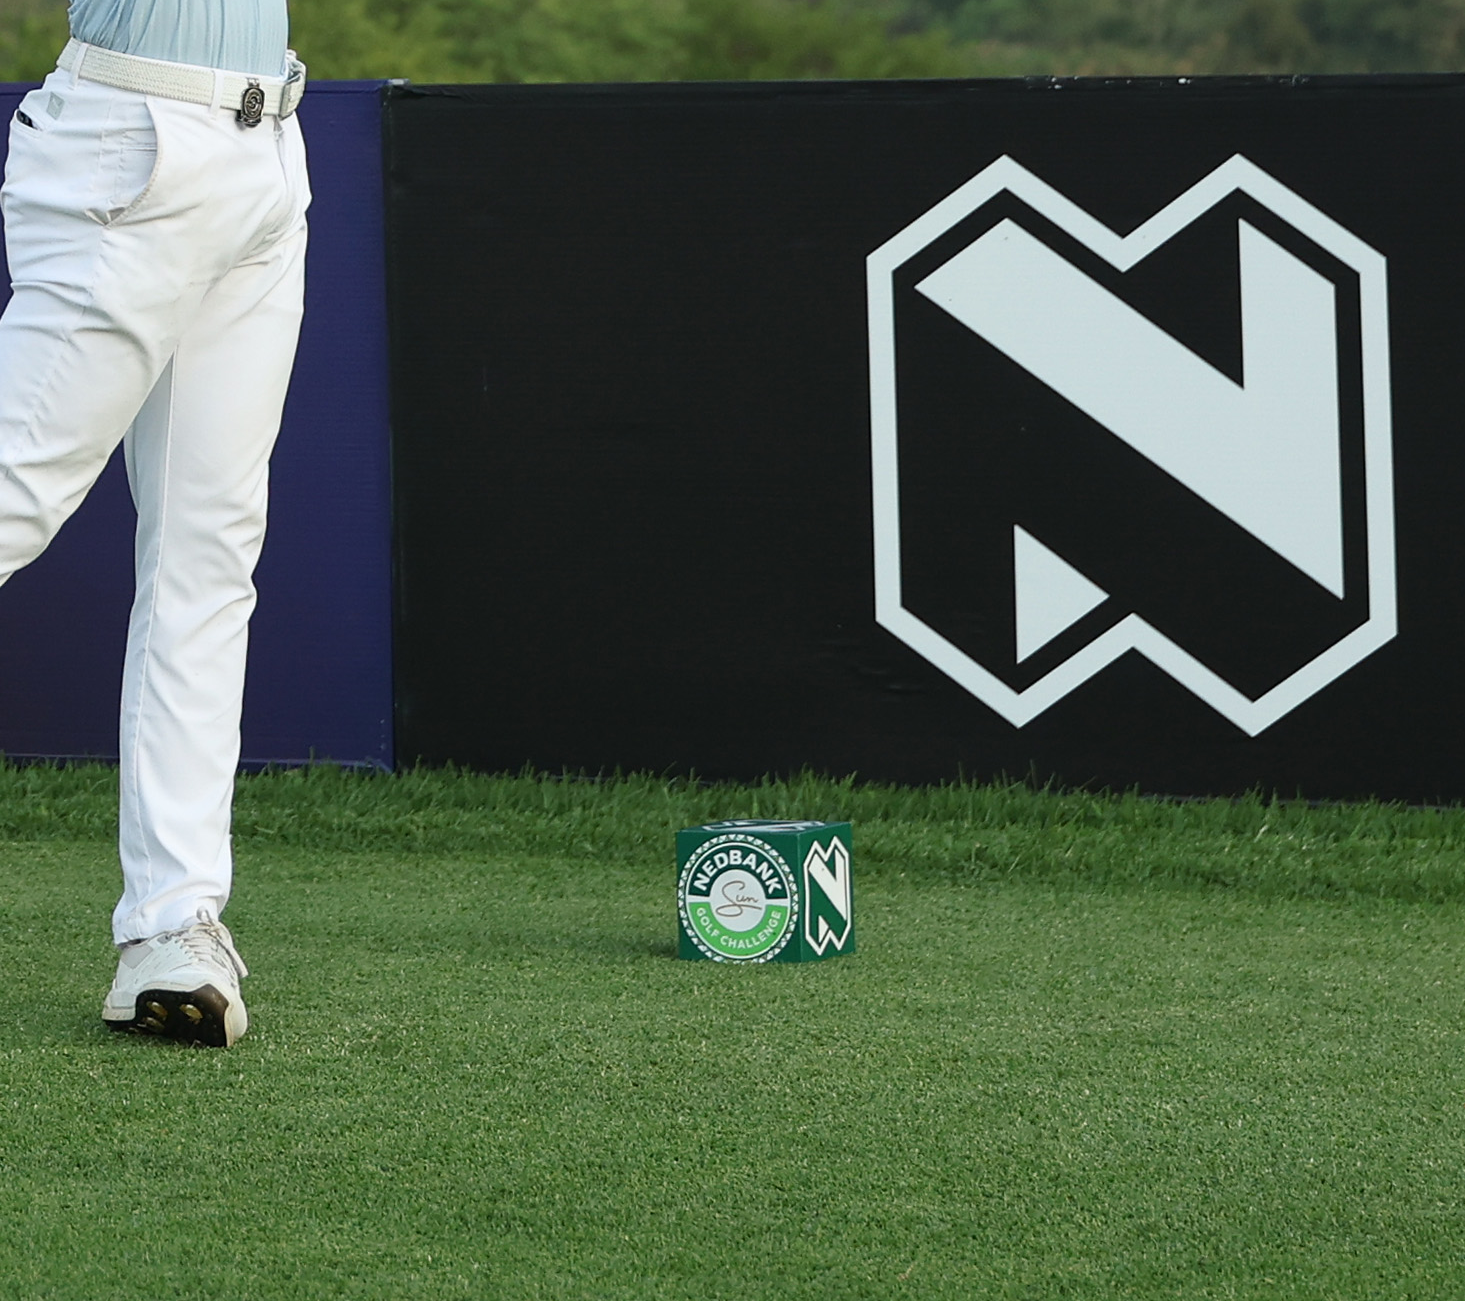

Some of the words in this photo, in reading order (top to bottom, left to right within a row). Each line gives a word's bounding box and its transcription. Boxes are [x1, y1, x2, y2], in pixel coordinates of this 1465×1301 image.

[693, 850, 782, 894] NEDBANK
[715, 880, 762, 917] Sun
[696, 907, 720, 937] GOLF
[720, 910, 782, 949] CHALLENGE
